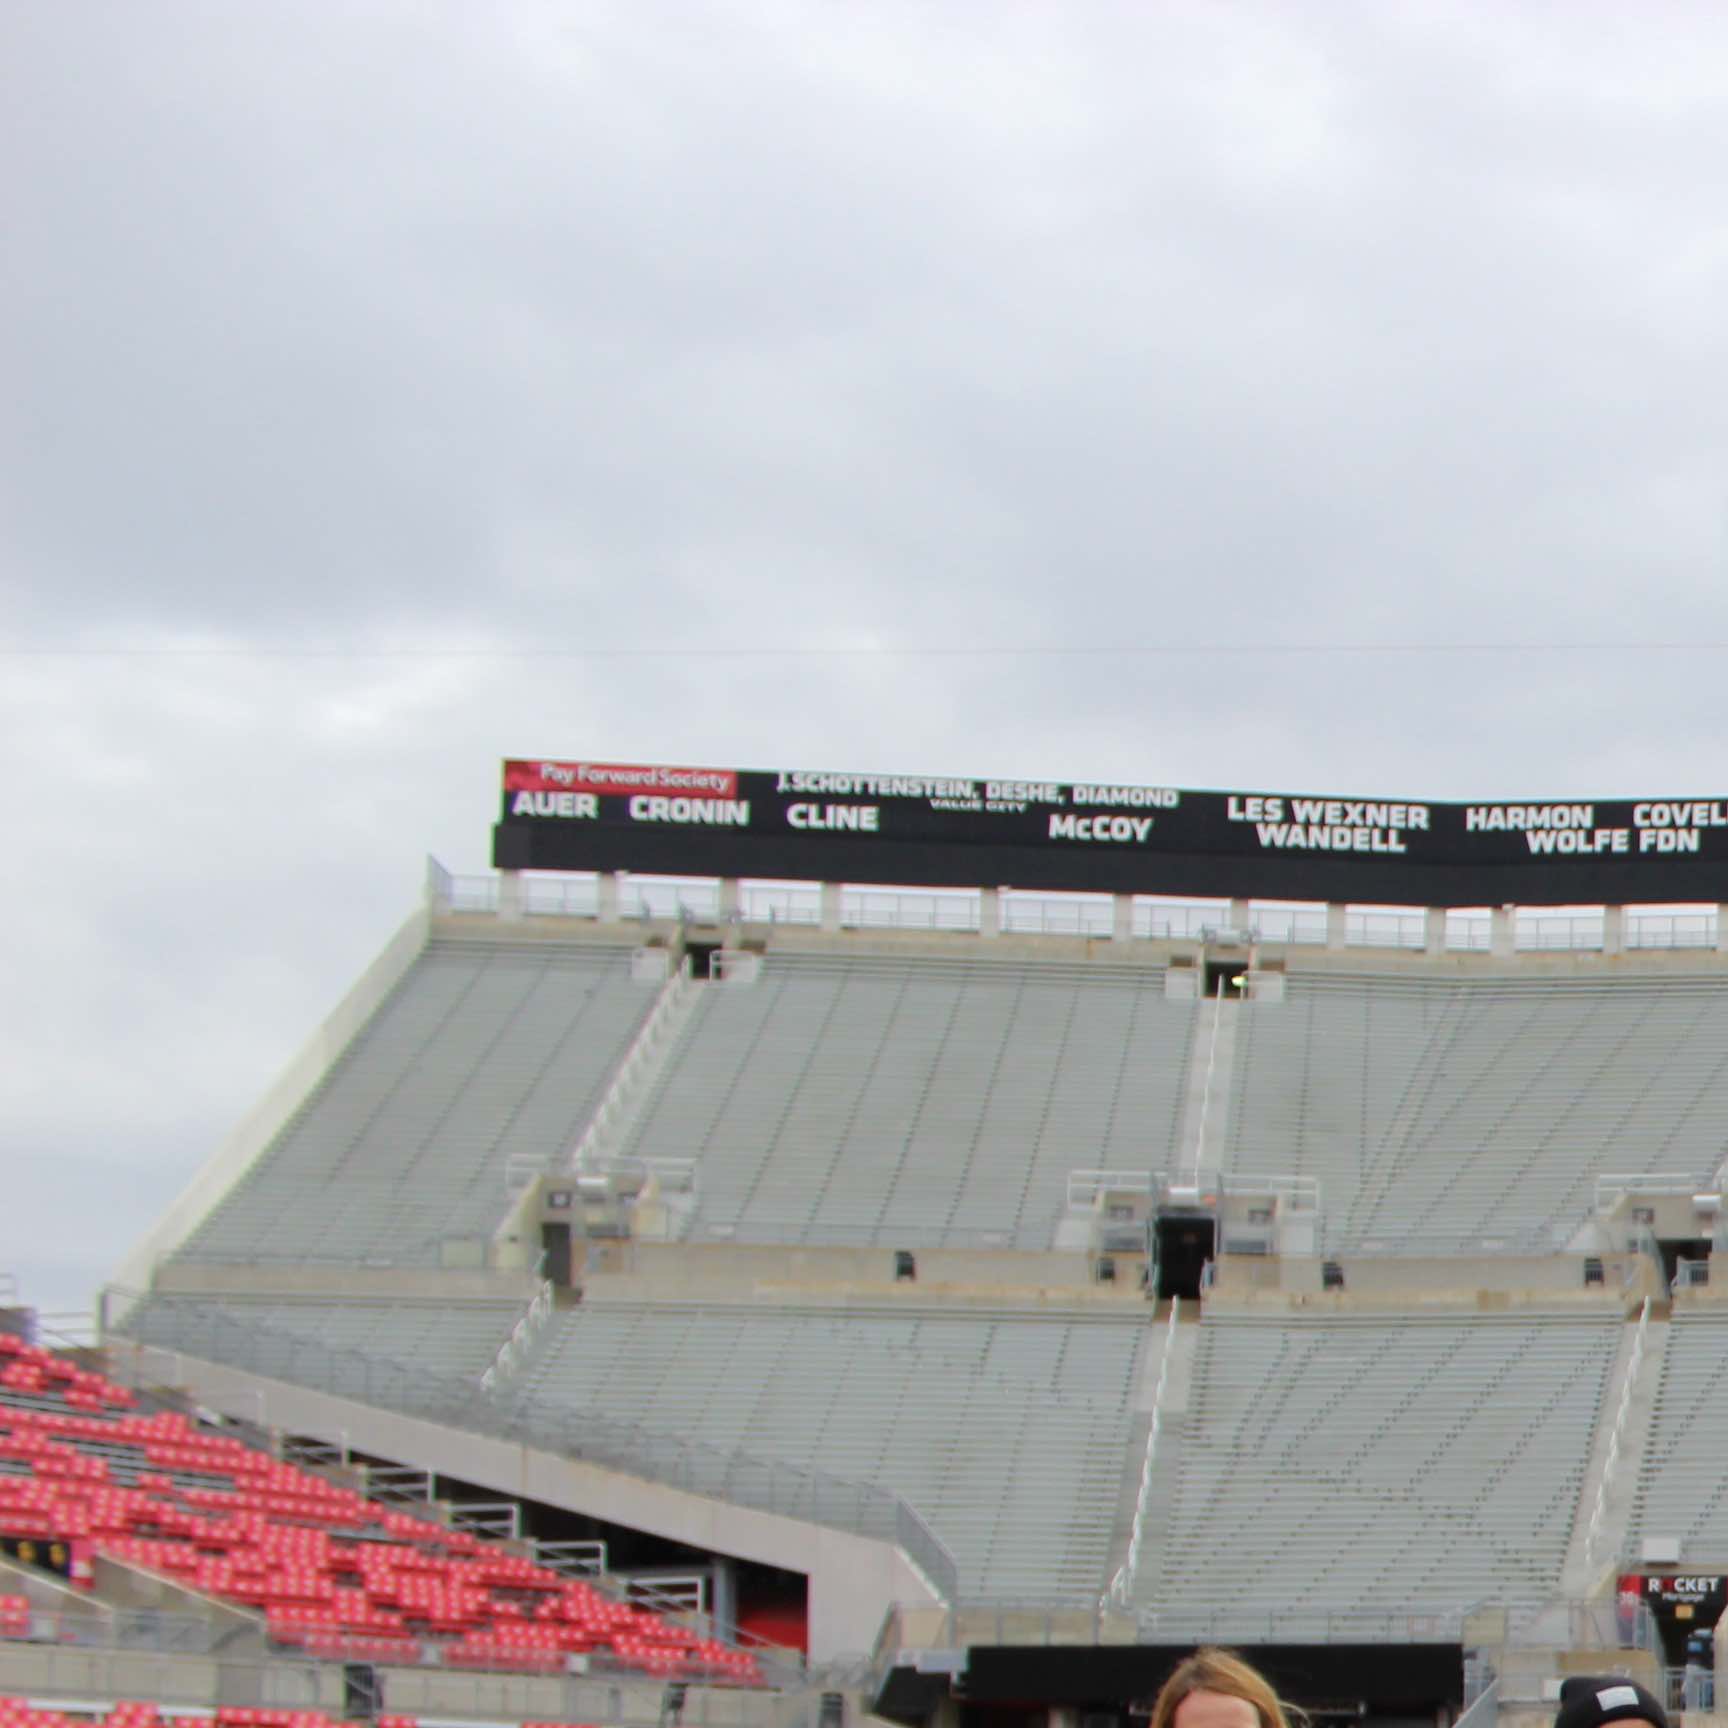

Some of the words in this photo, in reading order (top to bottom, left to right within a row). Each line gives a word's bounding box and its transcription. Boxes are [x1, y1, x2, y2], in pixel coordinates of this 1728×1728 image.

[541, 764, 573, 784] Pay
[578, 766, 655, 786] Forward
[657, 769, 729, 792] Society
[513, 791, 598, 819] AUER
[629, 796, 749, 825] CRONIN
[1072, 786, 1179, 808] DIAMOND
[786, 803, 880, 831] CLINE
[1227, 796, 1283, 821] LES
[1292, 800, 1430, 830] WEXNER
[1466, 804, 1594, 830] HARMON
[1049, 814, 1153, 842] McCOY
[1256, 823, 1407, 853] WANDELL
[1526, 829, 1629, 853] WOLFE
[1640, 828, 1700, 852] FDN
